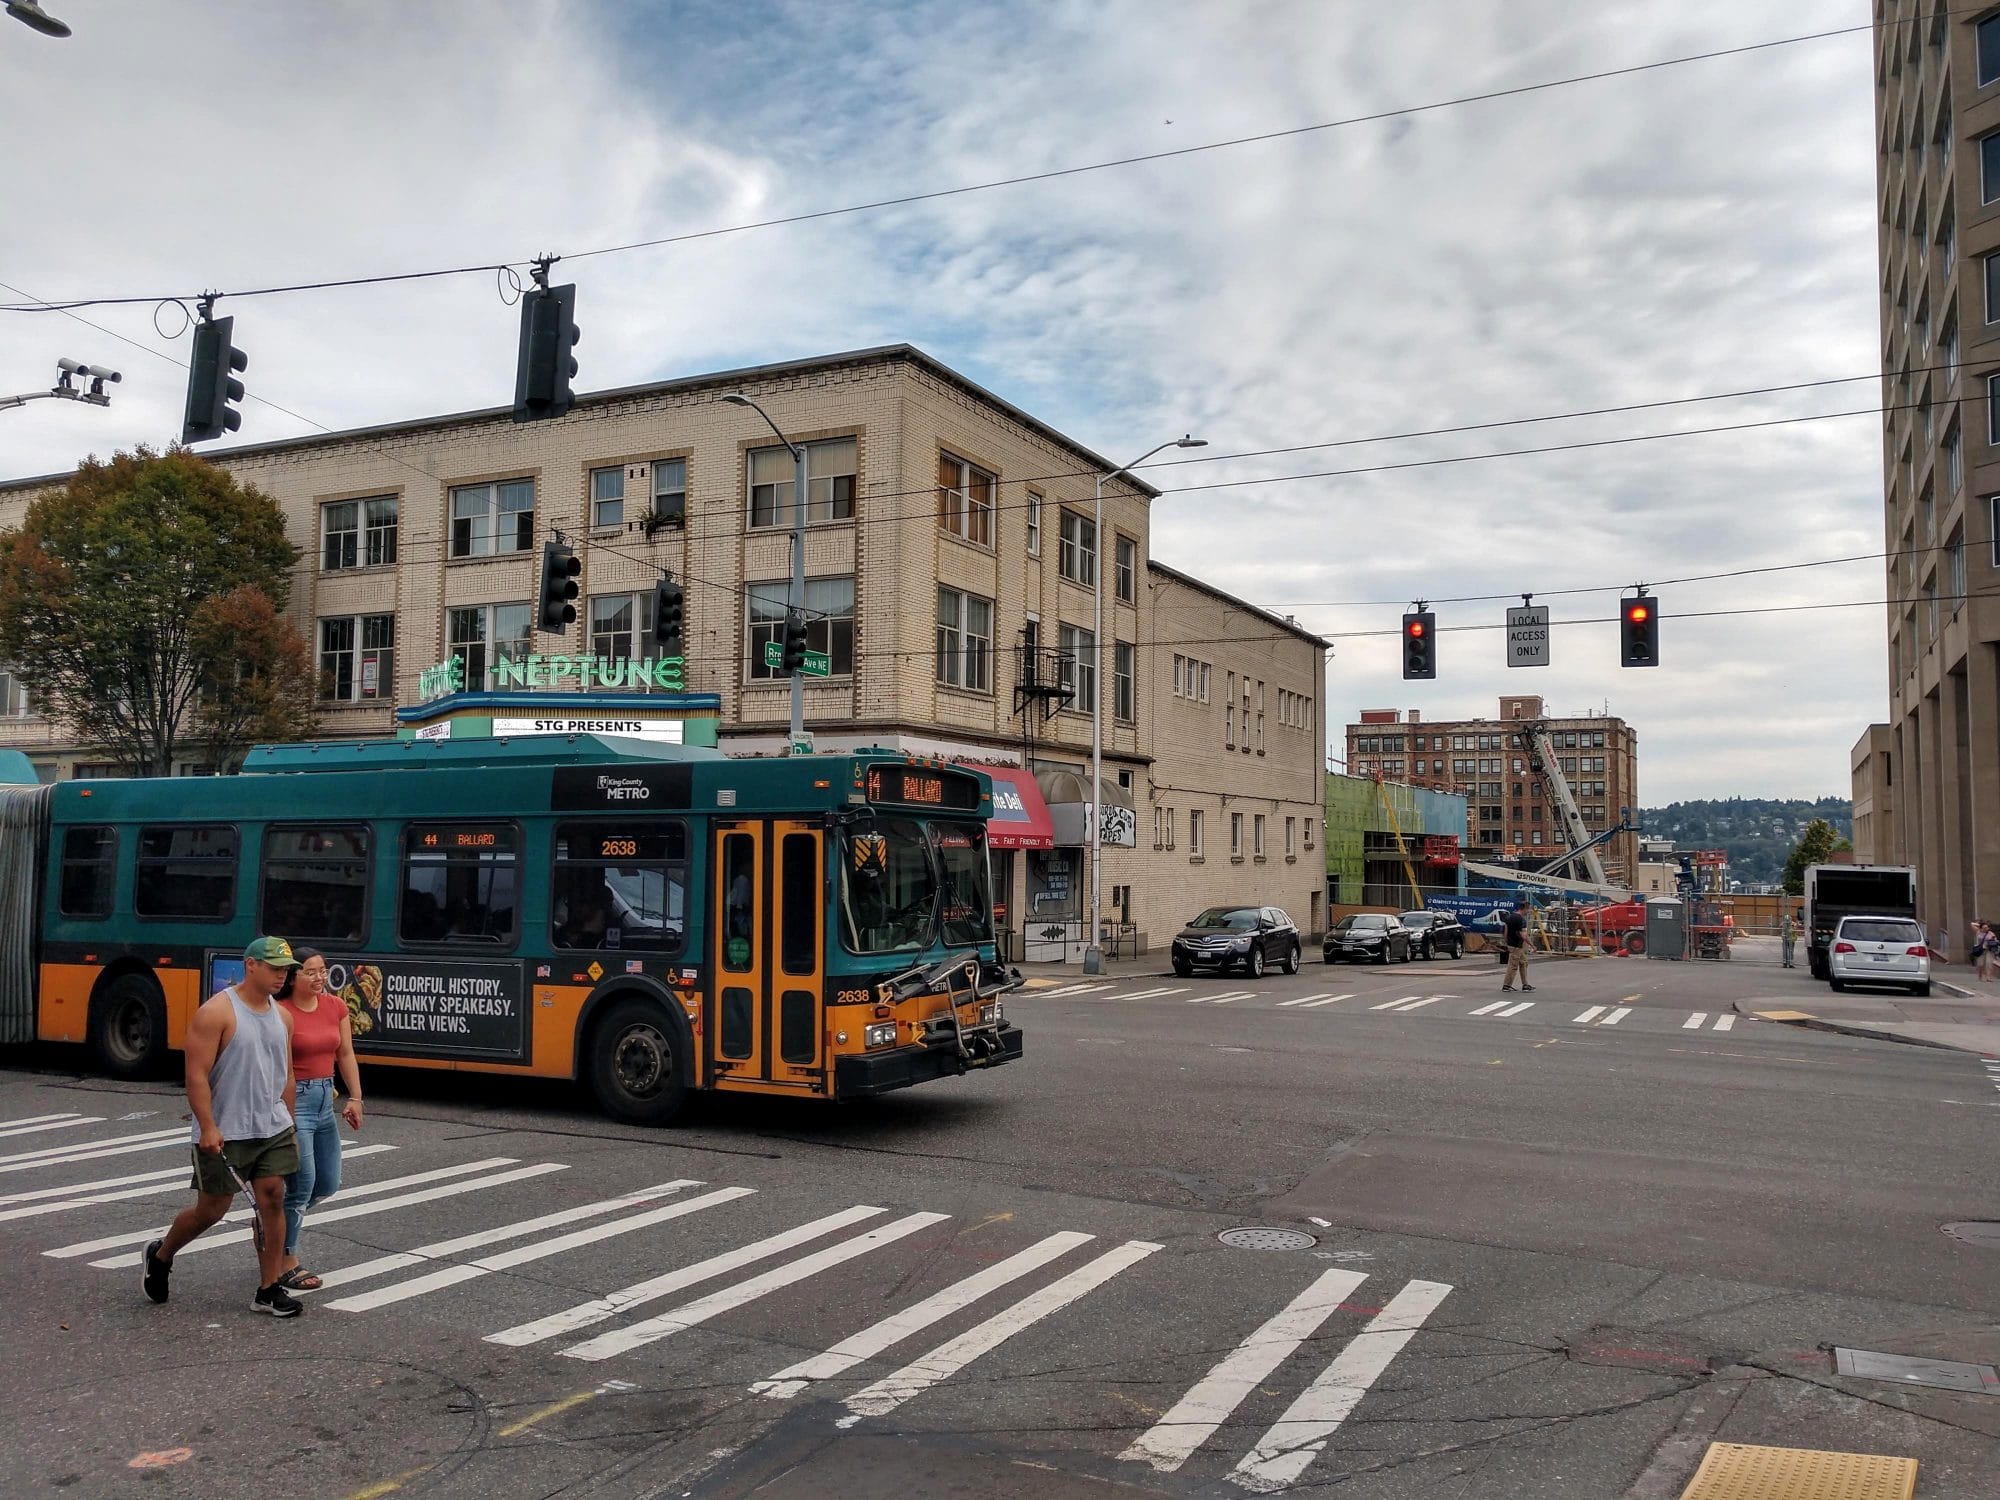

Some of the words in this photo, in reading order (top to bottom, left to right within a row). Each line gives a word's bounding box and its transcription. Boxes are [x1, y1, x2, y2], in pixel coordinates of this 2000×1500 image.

[1512, 616, 1540, 626] LOCAL
[1511, 630, 1545, 641] ACCESS
[1517, 646, 1540, 656] ONLY
[768, 648, 782, 662] Bro
[803, 657, 817, 669] Ave
[818, 660, 827, 671] NE
[499, 653, 685, 691] NEPTUNE
[534, 720, 563, 731] STG
[568, 721, 642, 732] PRESENTS
[609, 779, 621, 787] King
[622, 778, 643, 787] County
[903, 776, 942, 803] BALLARD
[607, 787, 650, 799] METRO
[1003, 792, 1024, 811] Deli
[424, 834, 438, 846] 44
[458, 834, 495, 846] BALLARD
[601, 840, 636, 856] 2638
[1459, 908, 1477, 916] 2021
[387, 975, 445, 994] COLORFUL
[448, 977, 504, 996] HISTORY.
[837, 989, 870, 1003] 2638
[386, 995, 436, 1012] SWANKY
[440, 997, 515, 1016] SPEAKEASY.
[386, 1012, 425, 1030] KILLER
[429, 1015, 471, 1033] VIEWS.
